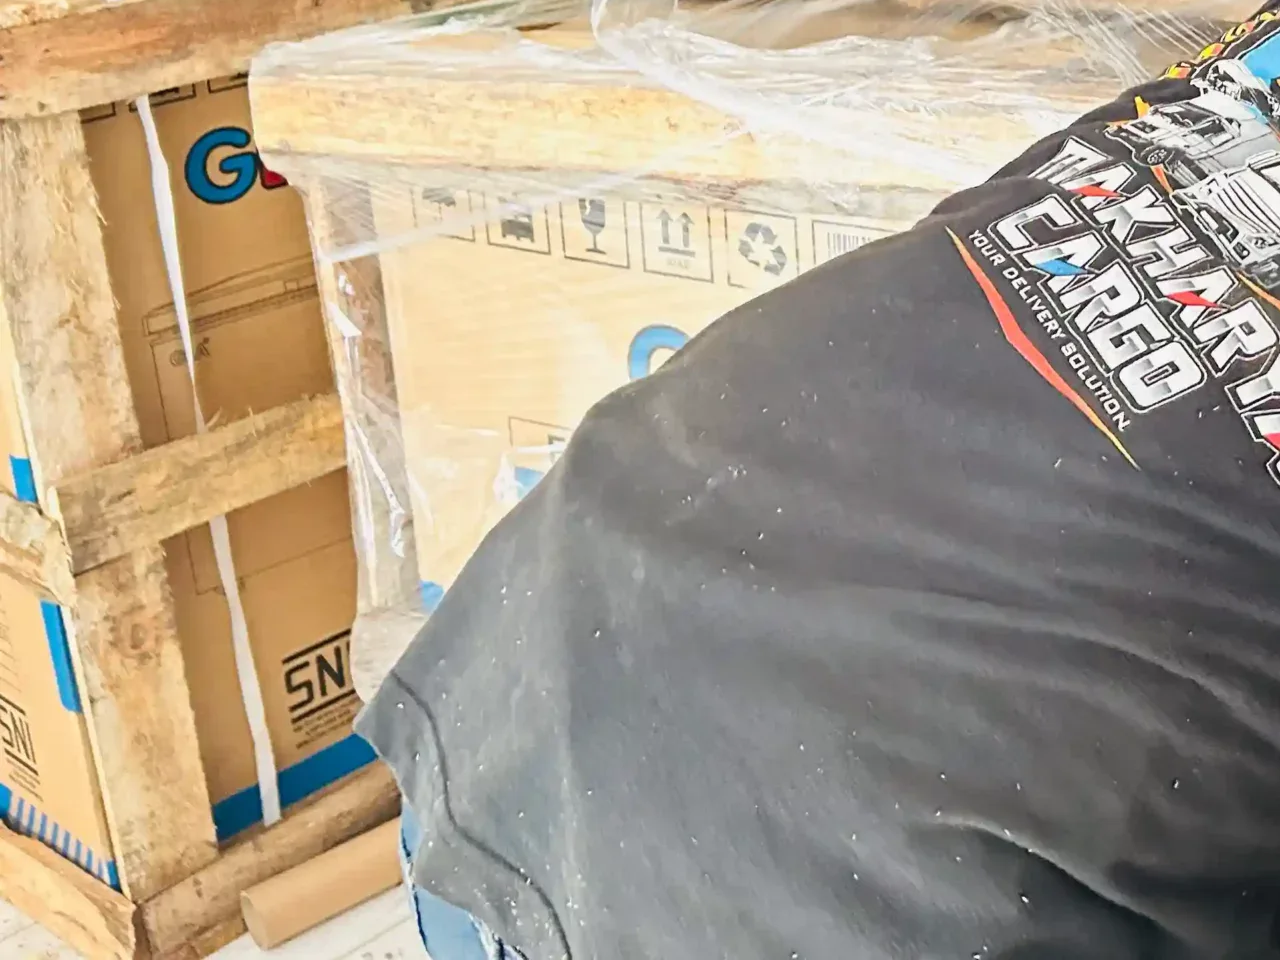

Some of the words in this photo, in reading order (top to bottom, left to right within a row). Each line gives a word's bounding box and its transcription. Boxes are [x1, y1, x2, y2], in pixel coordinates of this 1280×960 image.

[968, 229, 1006, 267] YOUR
[1002, 266, 1066, 340] DELIVERY
[1060, 341, 1131, 432] SOLUTION
[986, 193, 1207, 414] CARGO
